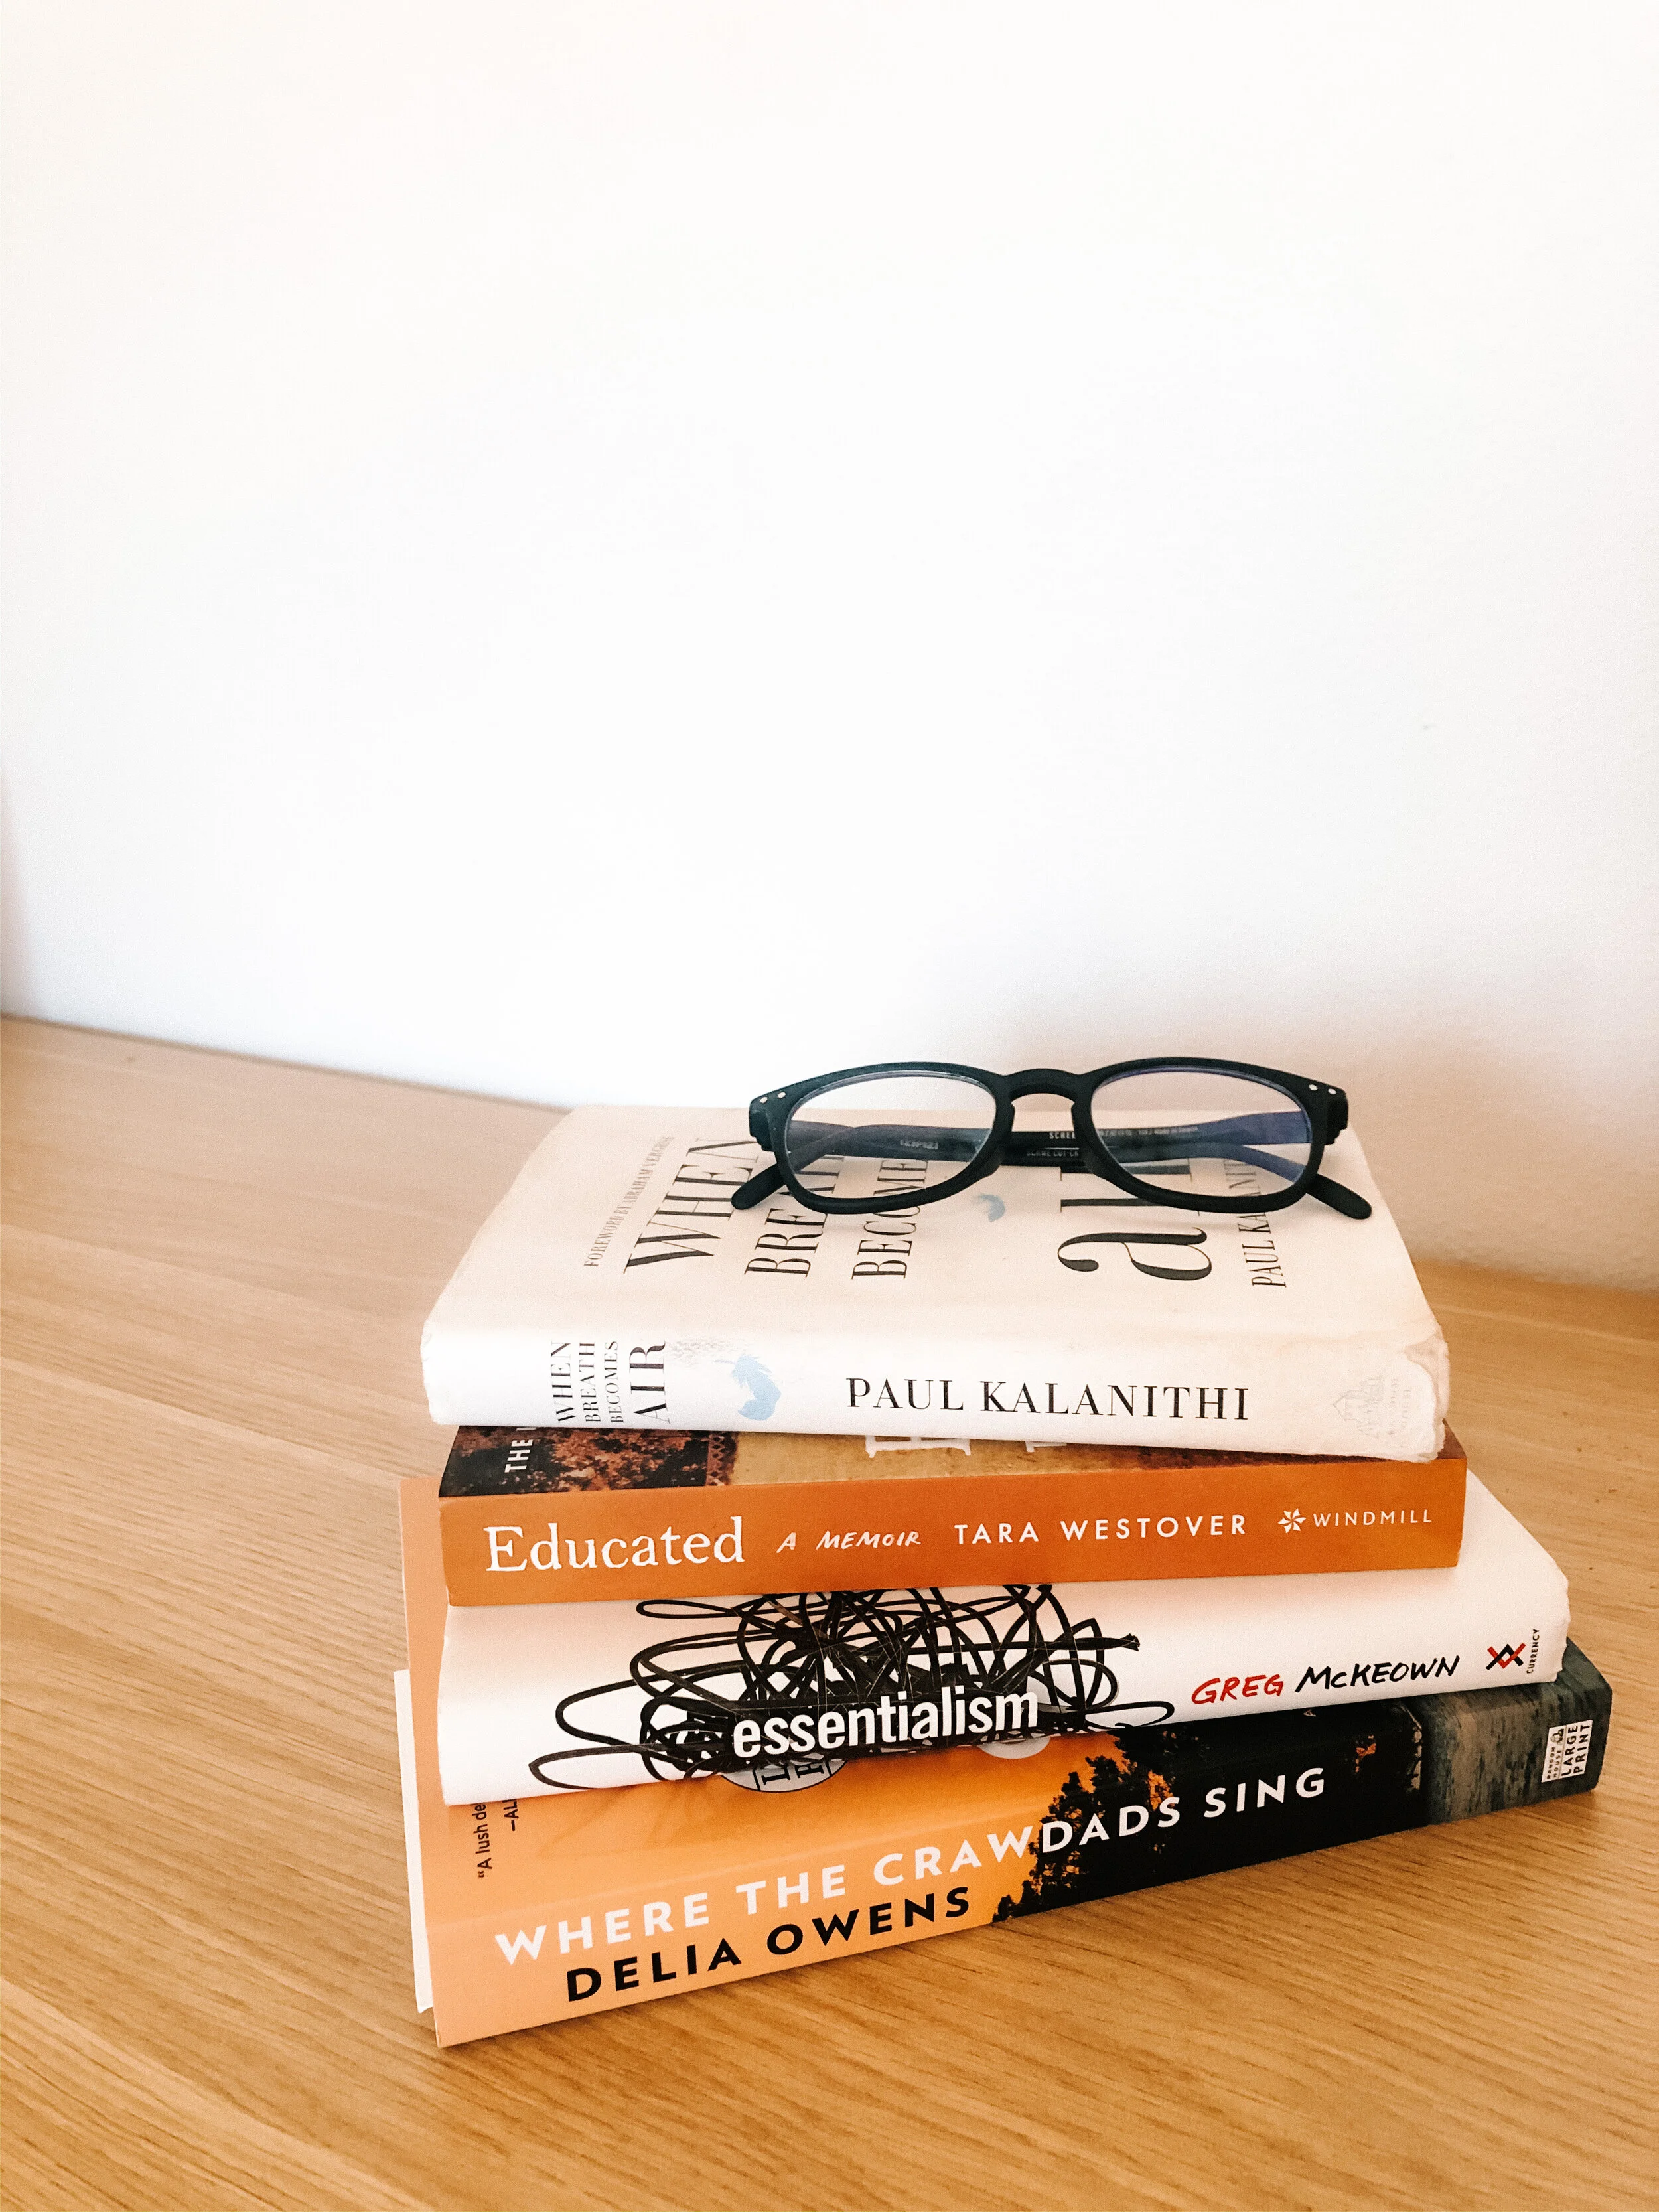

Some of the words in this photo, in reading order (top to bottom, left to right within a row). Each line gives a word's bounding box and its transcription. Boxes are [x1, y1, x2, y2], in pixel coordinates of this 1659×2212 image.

[623, 1137, 758, 1274] WHEN
[1242, 1240, 1287, 1288] PAUL
[550, 1341, 576, 1422] WHEN
[579, 1341, 601, 1422] BREATH
[605, 1341, 624, 1423] BECOMES
[629, 1339, 670, 1424] AIR
[845, 1378, 964, 1411] PAUL
[979, 1380, 1249, 1421] KALANITHI
[504, 1439, 534, 1473] THE
[483, 1516, 745, 1572] Educated
[776, 1532, 797, 1554] A
[816, 1530, 922, 1551] MEMOIR
[954, 1521, 1039, 1545] TARA
[1060, 1514, 1246, 1542] WESTOVER
[1313, 1509, 1432, 1528] WINDMILL
[1526, 1628, 1540, 1674] CURRENCY
[1191, 1674, 1285, 1705] GREG
[733, 1686, 1039, 1759] essentialism
[1561, 1726, 1578, 1777] LARGE
[1573, 1725, 1591, 1773] PRINT
[473, 1823, 490, 1854] lush
[494, 1892, 709, 1966] WHERE
[735, 1864, 846, 1915] THE
[873, 1796, 1181, 1886] CRAWDADS
[1203, 1767, 1325, 1818] SING
[567, 1938, 742, 2002] DELIA
[766, 1886, 970, 1956] OWENS
